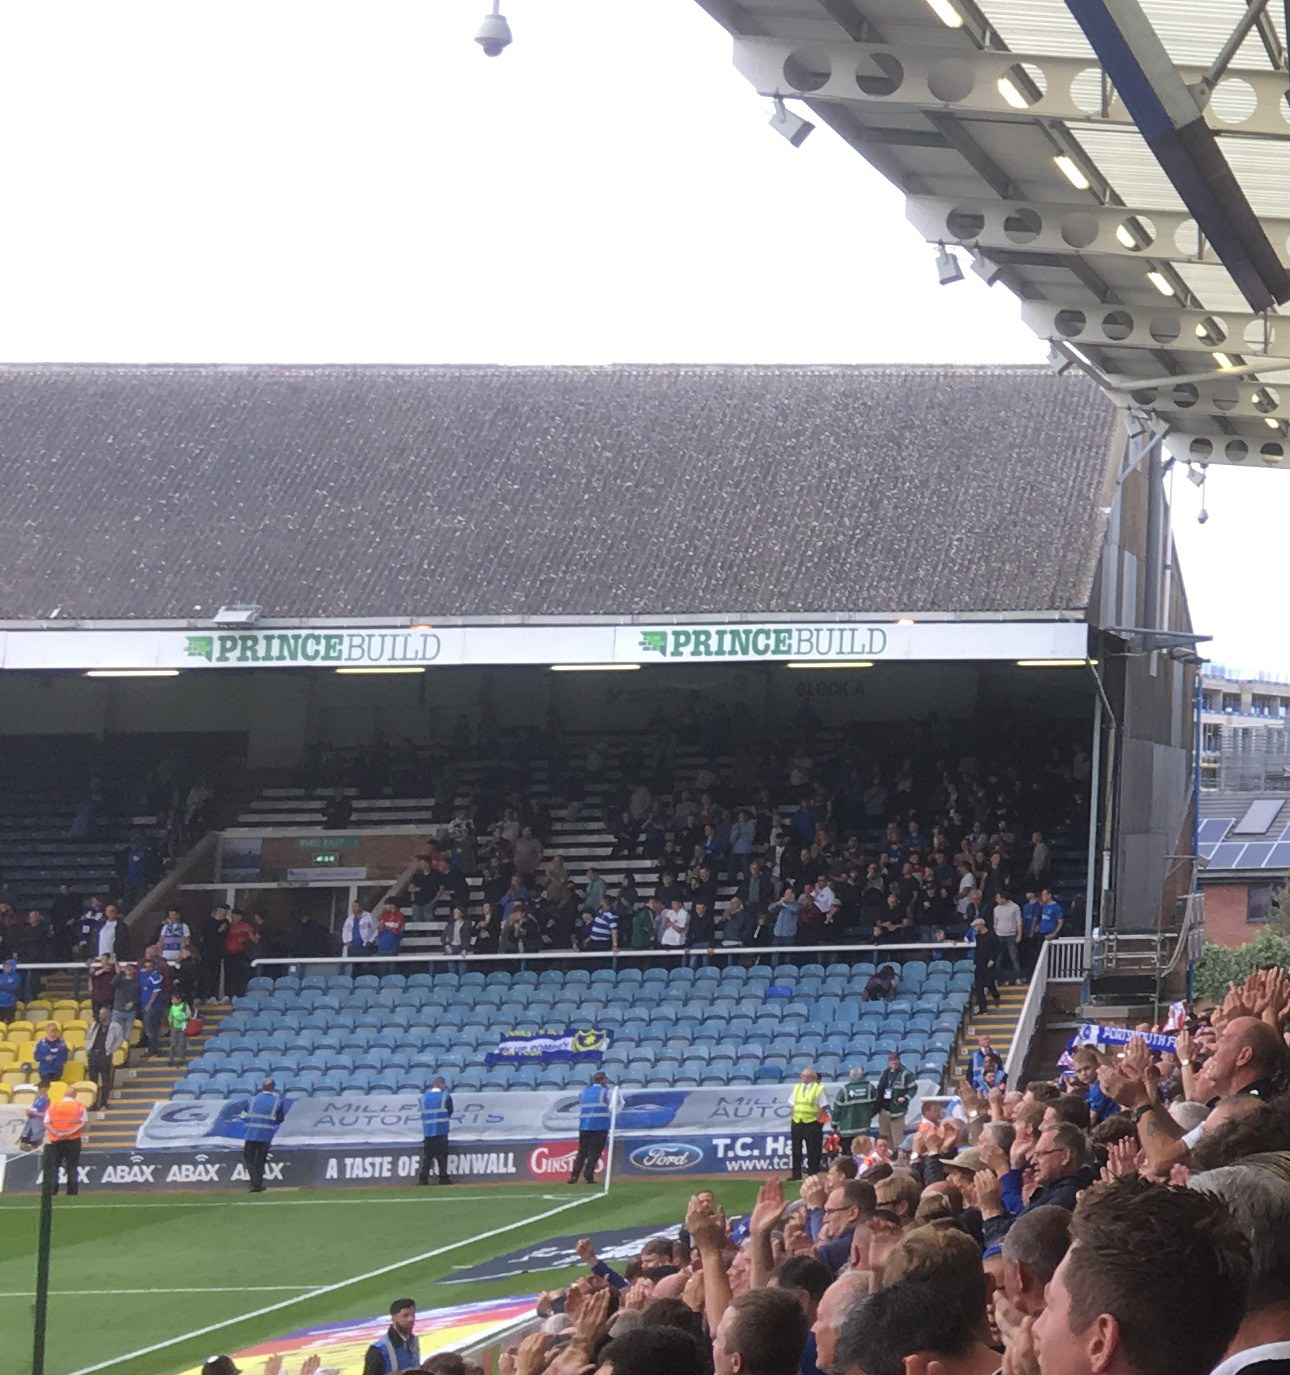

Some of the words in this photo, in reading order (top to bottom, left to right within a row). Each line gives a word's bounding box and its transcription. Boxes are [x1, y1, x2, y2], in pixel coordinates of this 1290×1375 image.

[216, 633, 441, 662] PRINCEBUILD
[670, 628, 888, 657] PRINCEBUILD
[643, 1147, 689, 1167] Ford
[712, 1138, 760, 1158] T.C.
[101, 1165, 156, 1184] ABAX
[166, 1164, 220, 1183] ABAX
[325, 1158, 338, 1179] A
[344, 1156, 393, 1179] TASTE
[398, 1155, 420, 1177] OF
[424, 1152, 516, 1176] RNWALL
